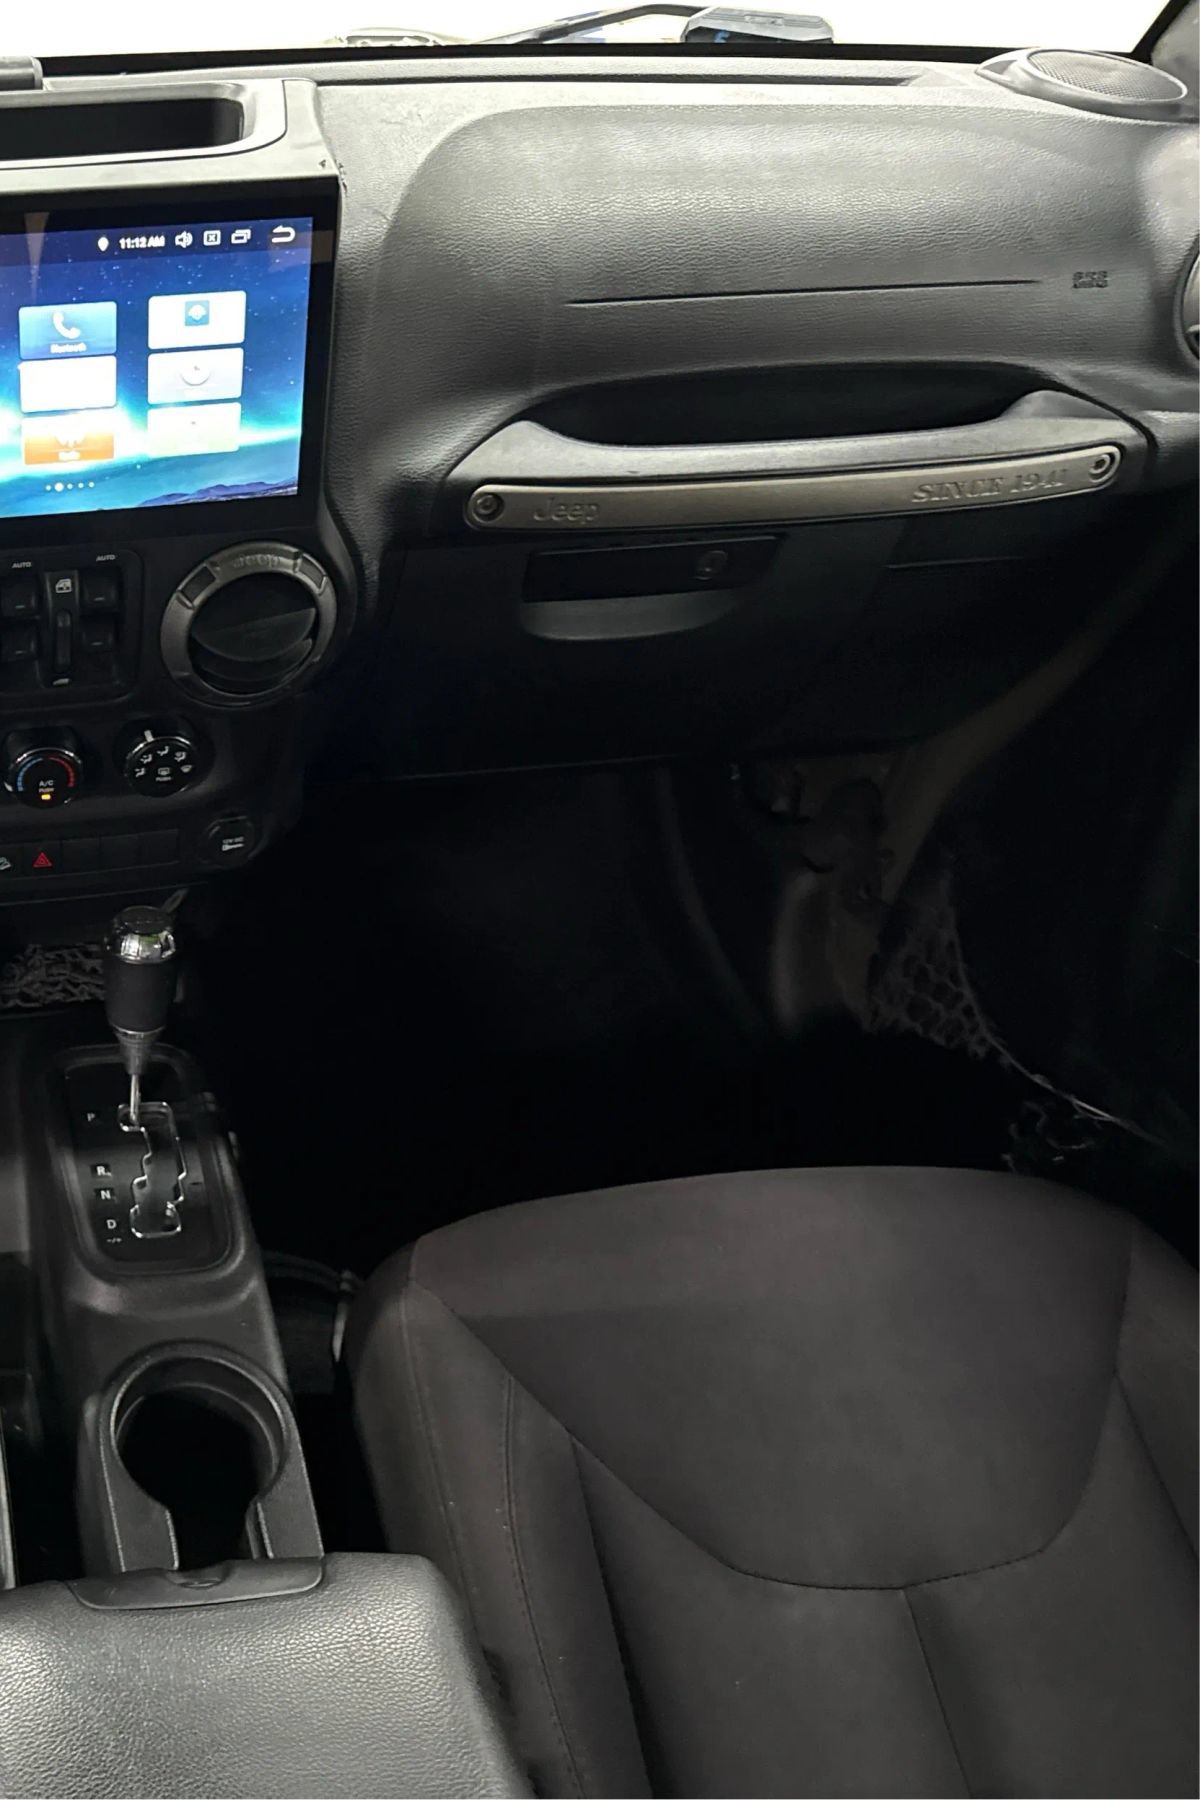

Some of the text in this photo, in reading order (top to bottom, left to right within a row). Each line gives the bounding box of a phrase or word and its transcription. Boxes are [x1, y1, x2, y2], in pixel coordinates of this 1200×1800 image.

[119, 236, 146, 250] 11:12
[911, 477, 1006, 503] SINCE
[533, 496, 599, 525] Jeep
[95, 554, 116, 562] AUTO
[12, 561, 32, 569] AUTO
[87, 1113, 96, 1121] P
[96, 1166, 106, 1177] R
[100, 1190, 111, 1200] N
[106, 1219, 117, 1230] D
